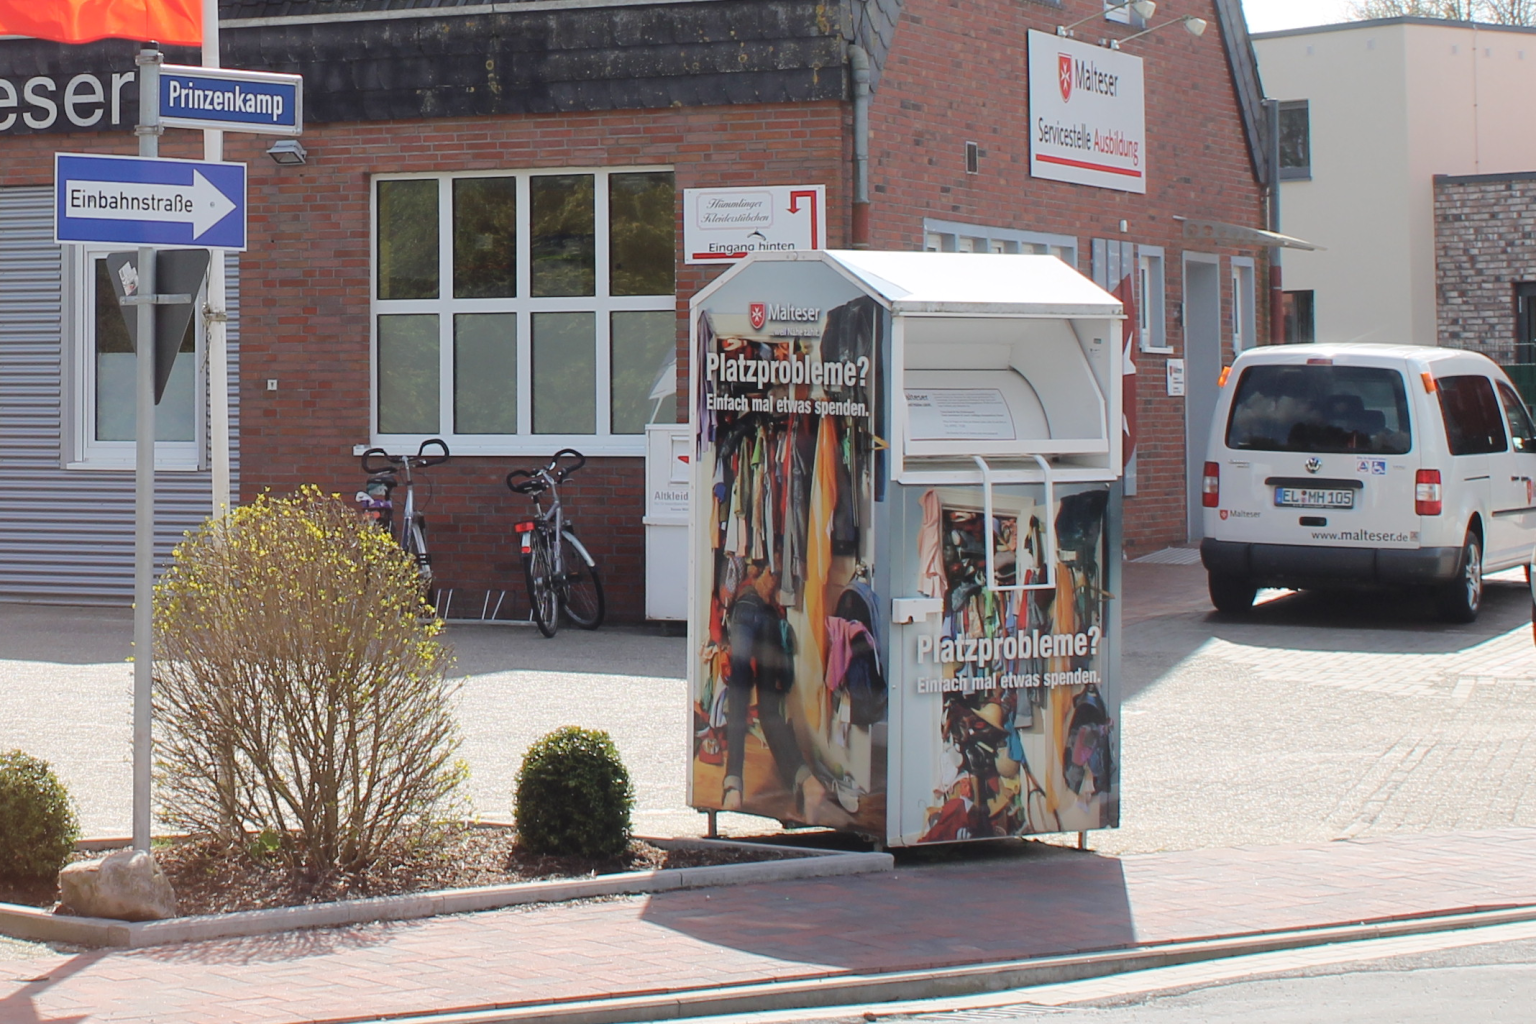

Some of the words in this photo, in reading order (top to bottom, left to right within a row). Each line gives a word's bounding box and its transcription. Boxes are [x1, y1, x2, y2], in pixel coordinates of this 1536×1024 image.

[1075, 59, 1118, 97] Malteser
[167, 80, 284, 122] Prinzenkamp
[1038, 117, 1091, 151] Servicestelle
[1093, 128, 1140, 166] Ausbildung
[70, 187, 194, 213] Einbahnstraße
[706, 198, 764, 211] Hümmlinger
[758, 241, 795, 251] hinten
[768, 303, 821, 322] Malteser
[706, 352, 870, 389] Platzprobleme?
[706, 393, 749, 411] Einfach
[751, 395, 774, 412] mal
[776, 398, 812, 414] etwas
[814, 398, 870, 418] spenden.
[654, 491, 689, 501] Altkleid
[1283, 490, 1299, 502] EL
[1308, 491, 1325, 503] MH
[1327, 492, 1352, 504] 105
[1229, 510, 1261, 518] Malteser
[1311, 529, 1409, 542] www.malteser.de
[917, 626, 1101, 666] Platzprobleme?
[917, 675, 968, 695] Einfach
[971, 673, 997, 692] mal
[1000, 673, 1040, 690] etwas
[1043, 668, 1102, 690] spenden.
